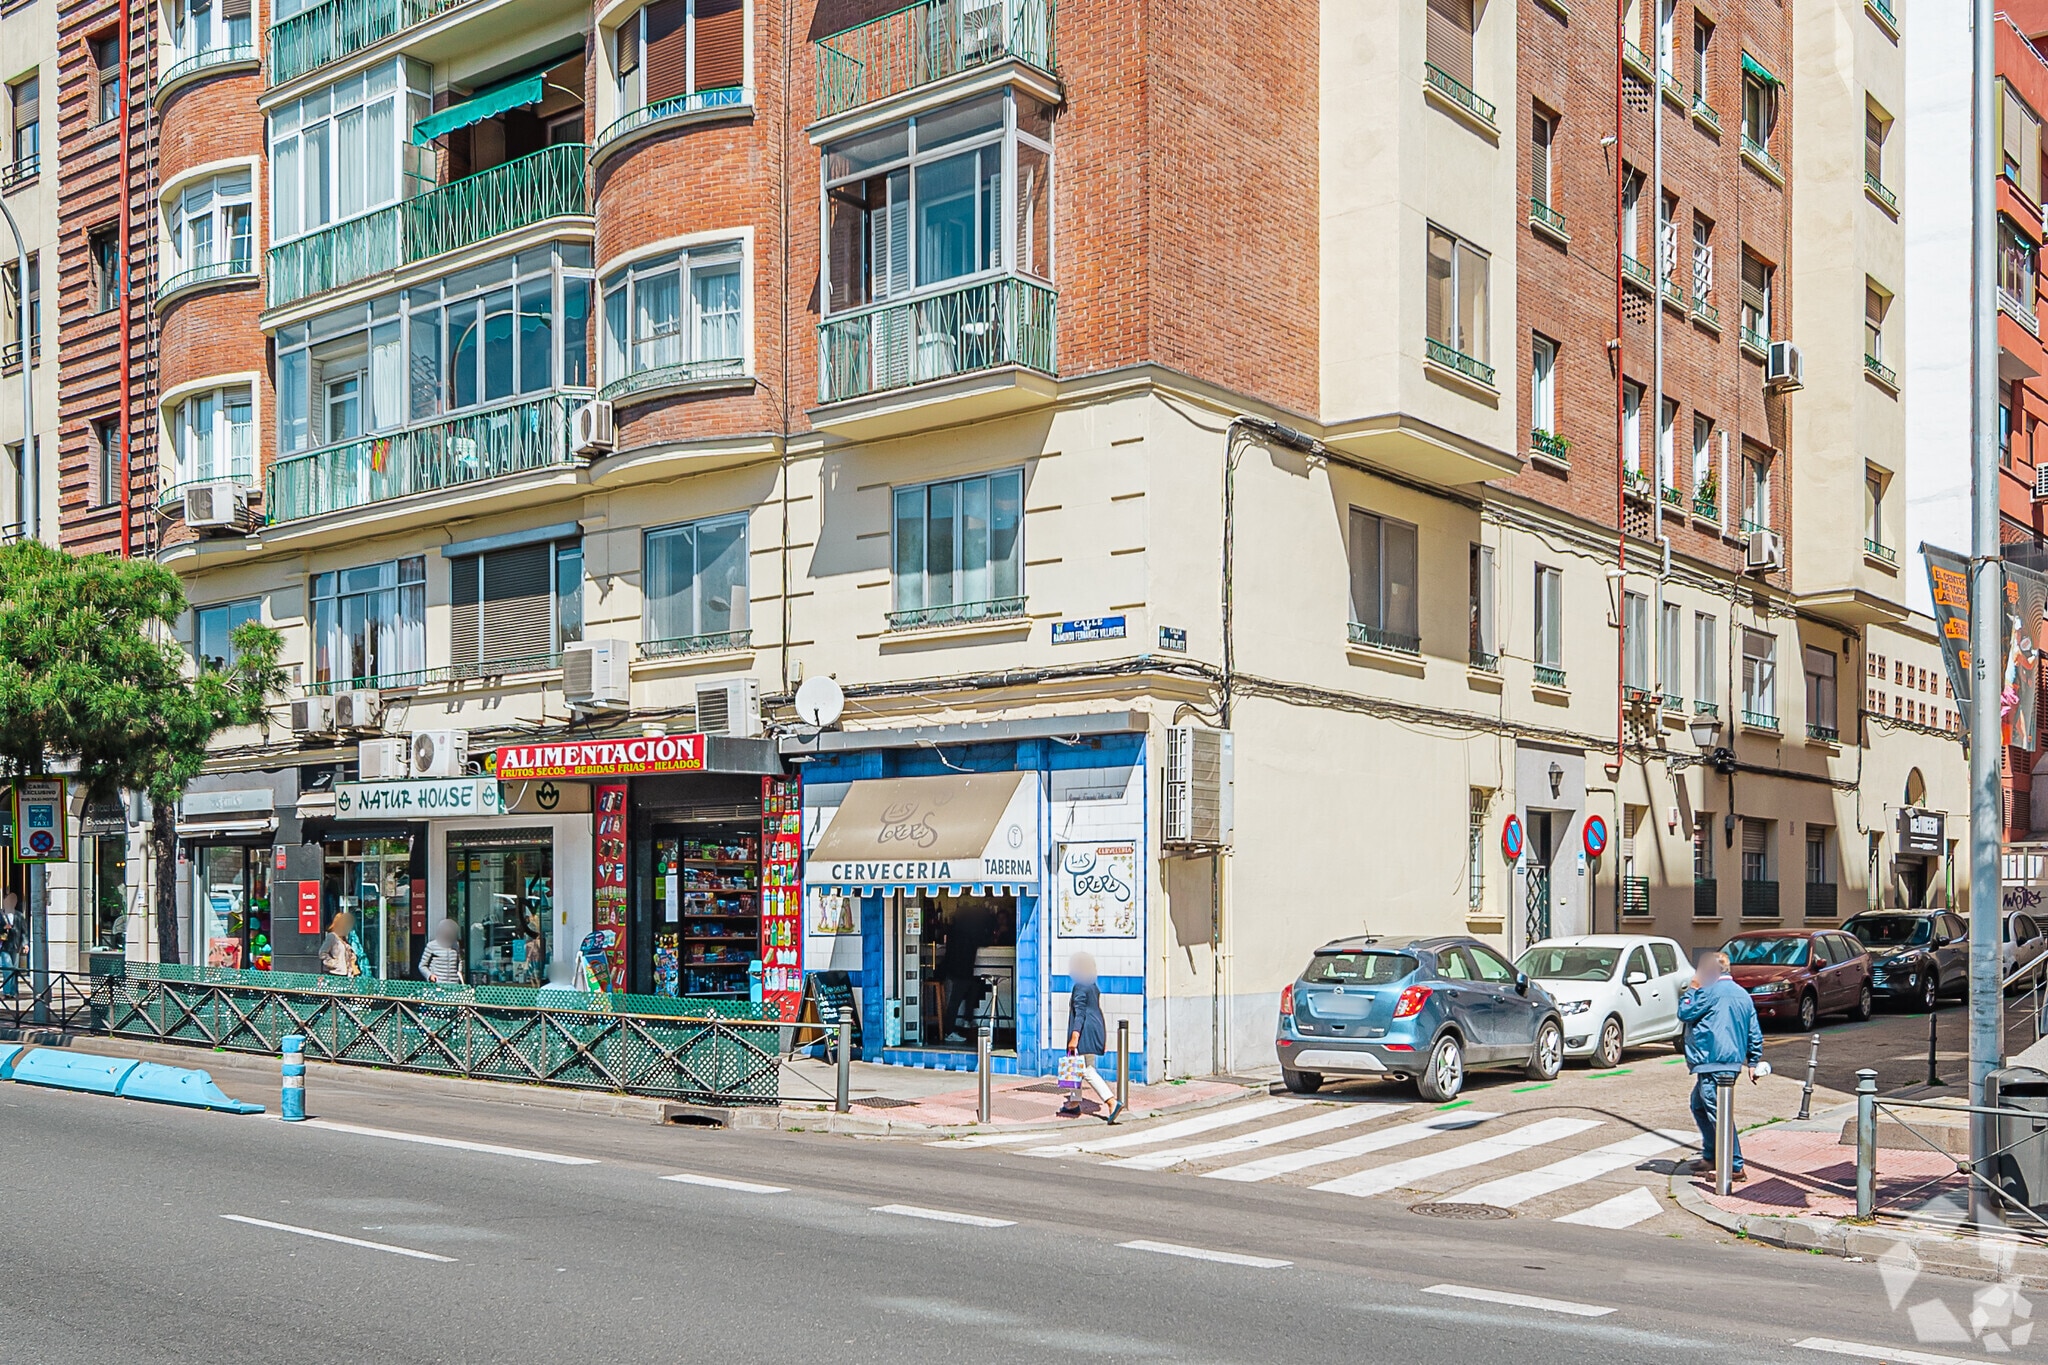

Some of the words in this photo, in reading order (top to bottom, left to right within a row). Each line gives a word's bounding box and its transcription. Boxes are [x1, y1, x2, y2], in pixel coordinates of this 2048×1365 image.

[1073, 618, 1103, 628] CALLE
[502, 736, 695, 769] ALIMENTACIÓN
[500, 767, 534, 778] FRUTOS
[536, 766, 566, 776] SECOS
[574, 764, 615, 775] BEBIDAS
[617, 762, 646, 773] FRIAS
[654, 759, 701, 771] HELADOS
[358, 789, 412, 811] NATUR
[418, 785, 474, 808] HOUSE
[831, 861, 952, 880] CERVECERIA
[984, 858, 1032, 876] TABERNA
